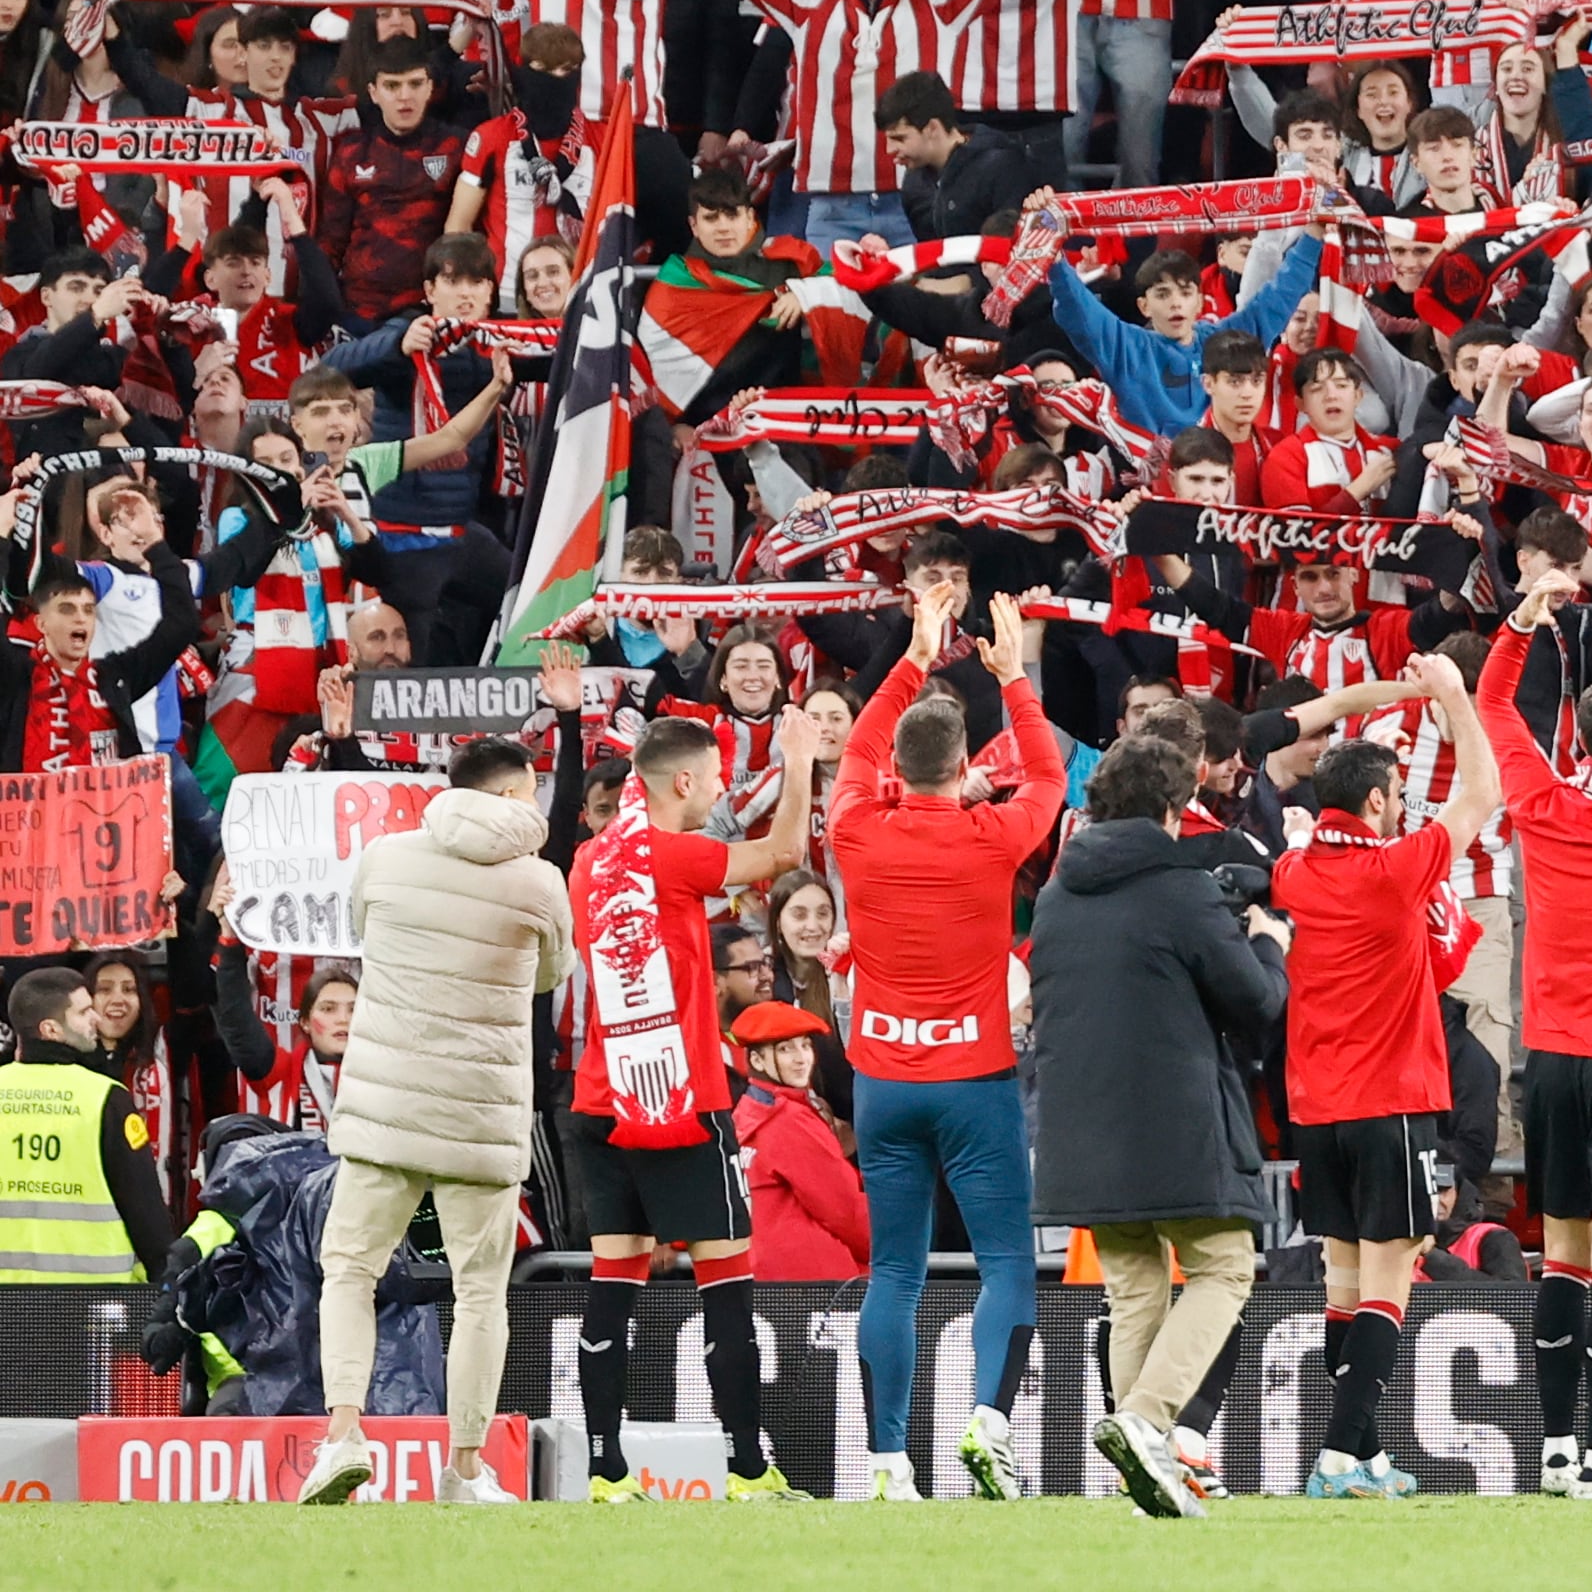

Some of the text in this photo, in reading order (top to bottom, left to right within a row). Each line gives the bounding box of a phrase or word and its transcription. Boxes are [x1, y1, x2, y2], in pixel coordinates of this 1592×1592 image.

[1273, 0, 1405, 56] Athletic
[1092, 183, 1285, 219] Athletic Club
[1195, 505, 1419, 566] Athletic Club
[57, 761, 163, 795] WILLIAMS
[228, 782, 323, 857] BEÑAT
[95, 821, 122, 873] 9
[860, 1010, 980, 1047] DIGI
[11, 1132, 61, 1162] 190
[8, 1179, 84, 1197] PROSEGUR
[118, 1438, 269, 1505] COPA
[640, 1466, 712, 1502] tve
